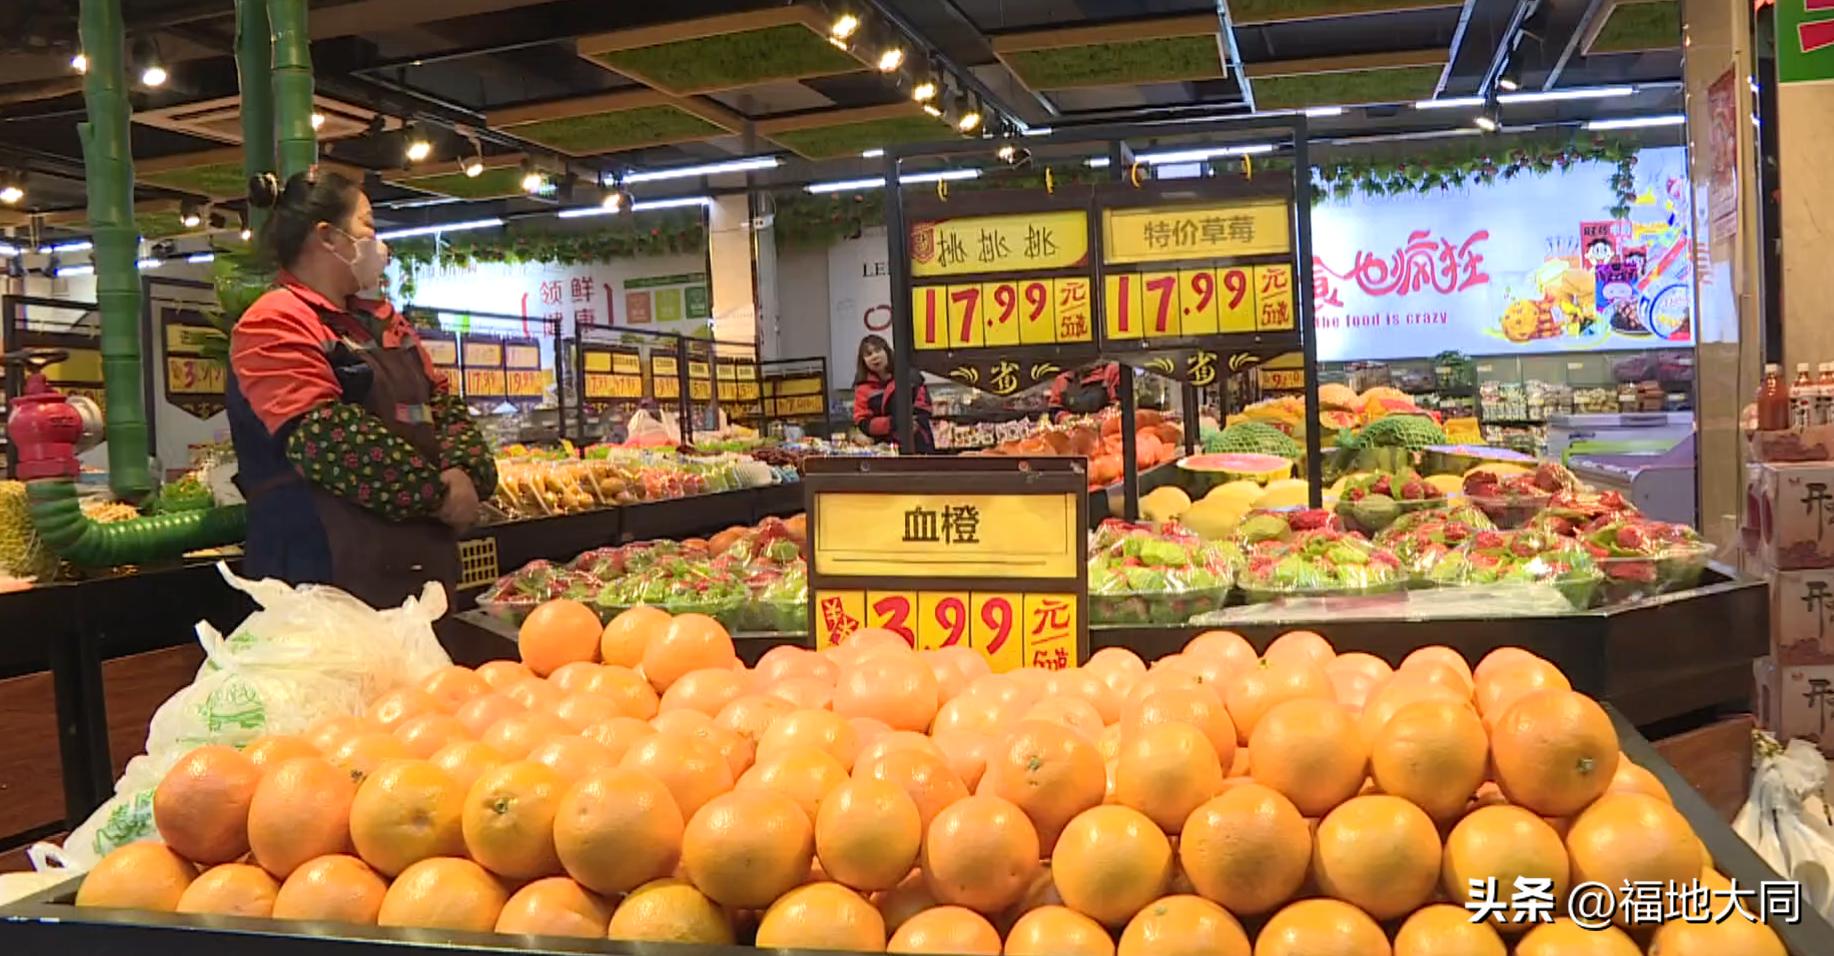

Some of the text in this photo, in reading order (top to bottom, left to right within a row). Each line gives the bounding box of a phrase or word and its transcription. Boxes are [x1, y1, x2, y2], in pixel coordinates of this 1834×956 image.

[1144, 205, 1255, 248] 特价草莓
[862, 262, 887, 277] LE
[1261, 267, 1288, 294] 元
[541, 276, 594, 304] 领鲜
[1060, 281, 1086, 306] 元
[1118, 269, 1248, 334] 17.99
[925, 282, 1047, 344] 17.99
[1346, 313, 1380, 328] food
[1386, 313, 1400, 326] is
[1406, 311, 1448, 325] crazy
[990, 360, 1020, 396] 省
[1187, 351, 1217, 386] 省
[902, 505, 980, 545] 血橙
[1032, 599, 1071, 635] 元
